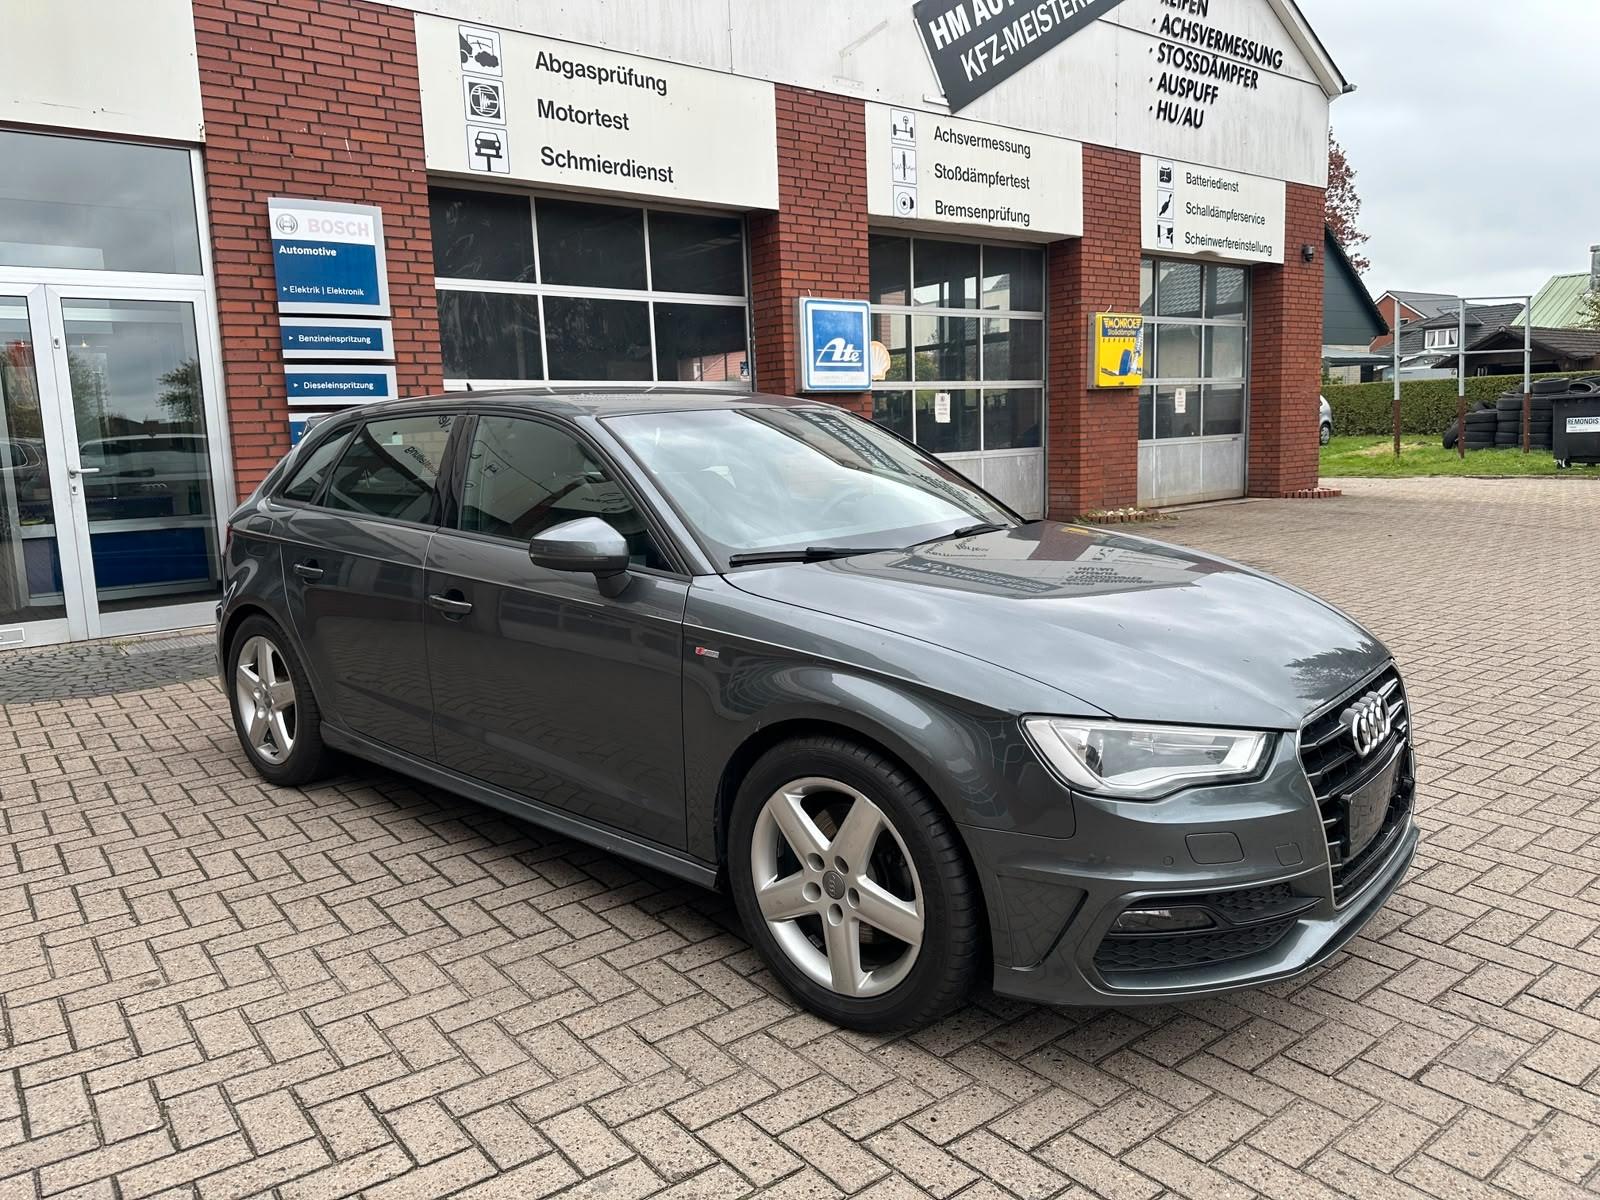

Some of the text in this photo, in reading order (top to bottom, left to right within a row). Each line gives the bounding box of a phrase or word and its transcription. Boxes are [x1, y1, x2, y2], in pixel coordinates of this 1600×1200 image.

[1160, 0, 1209, 18] IFEN
[928, 0, 1015, 51] HM AU
[960, 0, 1096, 82] KFZ-MEISTE
[1160, 13, 1283, 70] ACHSVERMESSUNG
[535, 51, 668, 96] Abgasprüfung
[1157, 42, 1259, 89] STOSSDÄMPFER
[1157, 72, 1219, 105] AUSPUFF
[537, 98, 630, 131] Motortest
[1156, 99, 1205, 129] HU/AU
[934, 125, 1031, 159] Achsvermessung
[540, 146, 675, 183] Schmierdienst
[934, 162, 1031, 190] Stoßdämpfertest
[1185, 172, 1239, 192] Batteriedienst
[935, 199, 1030, 227] Bremsenprüfung
[1185, 201, 1266, 225] Schalldämpferservice
[307, 218, 370, 238] BOSCH
[279, 245, 337, 257] Automotive
[1184, 231, 1273, 257] Scheinwerfereinstellung
[289, 285, 321, 295] Elektrik
[327, 287, 365, 296] Elektronik
[298, 334, 371, 345] Benzineinspritzung
[303, 381, 375, 391] Dieseleinspritzung
